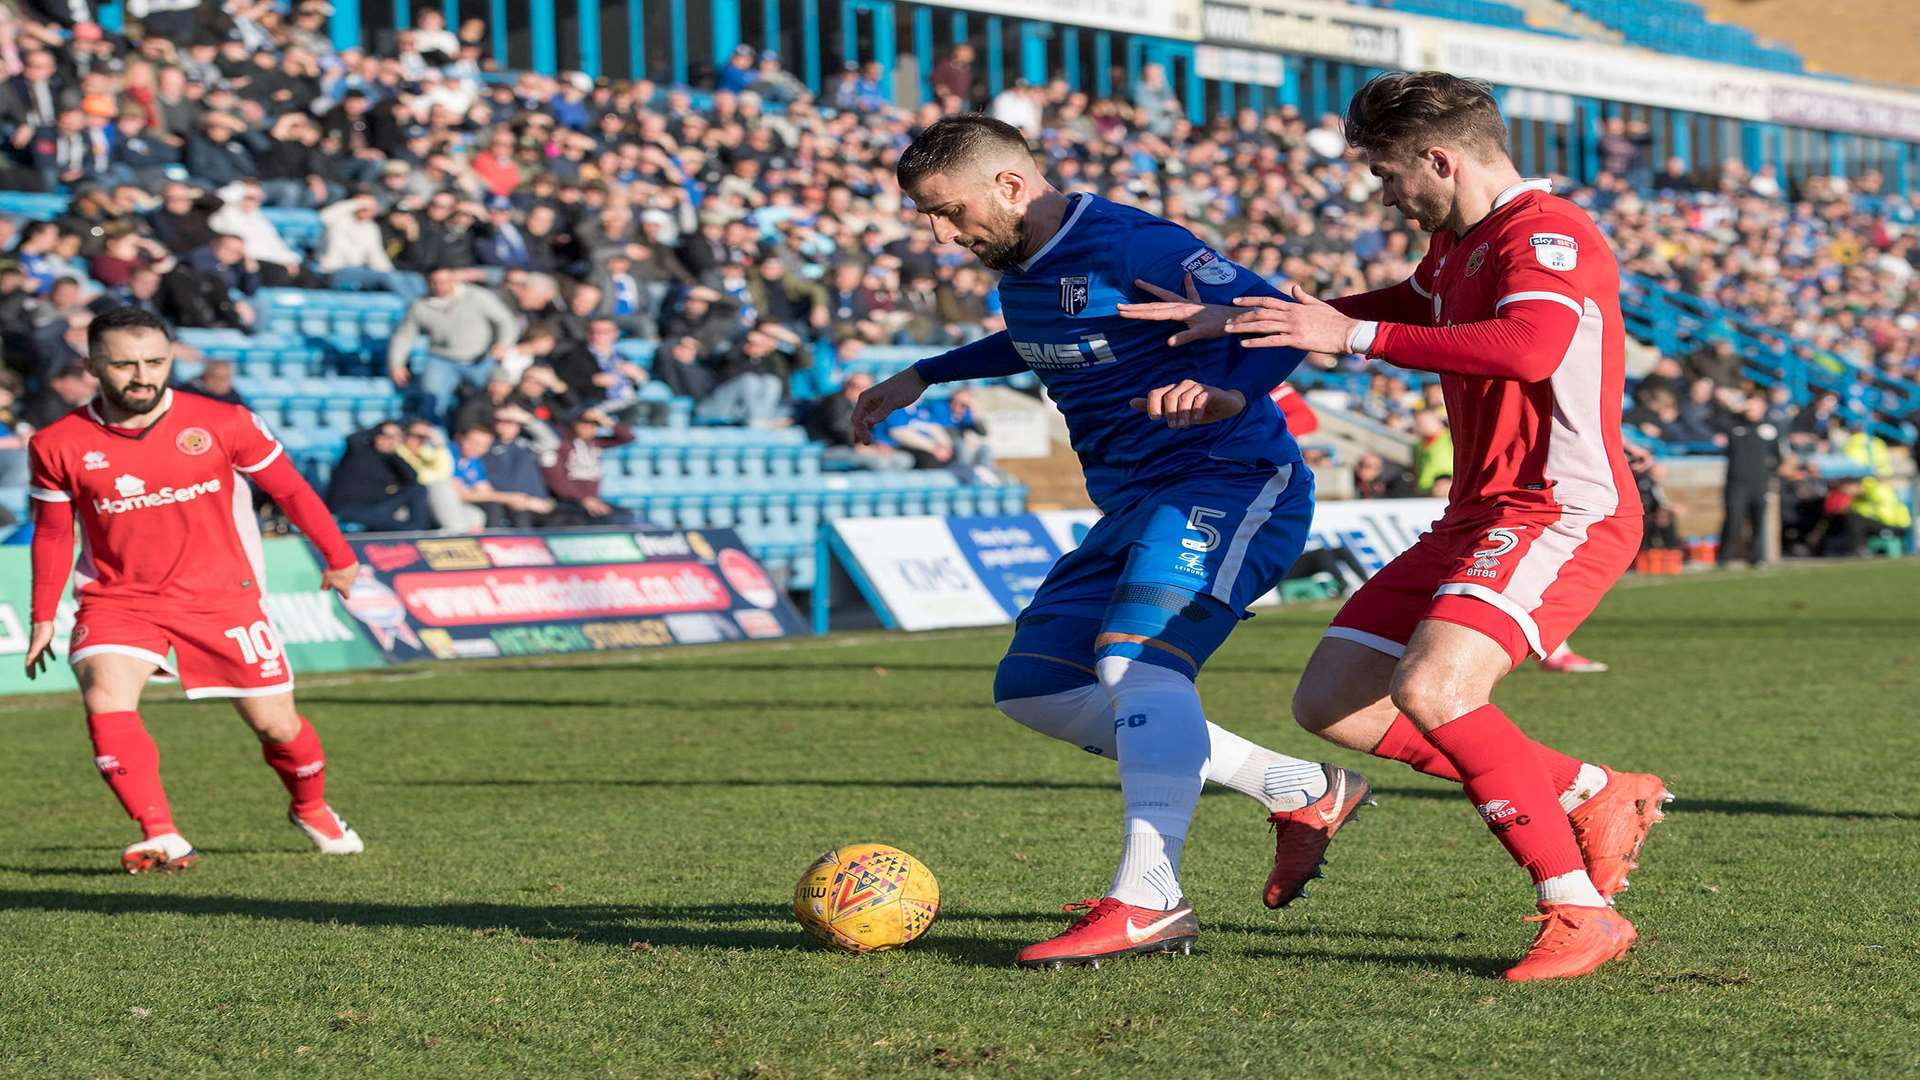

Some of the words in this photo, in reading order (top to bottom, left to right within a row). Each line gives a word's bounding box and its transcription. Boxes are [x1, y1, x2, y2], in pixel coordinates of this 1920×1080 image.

[92, 479, 221, 514] HomeServe
[1182, 505, 1227, 553] 5
[224, 620, 281, 664] 10
